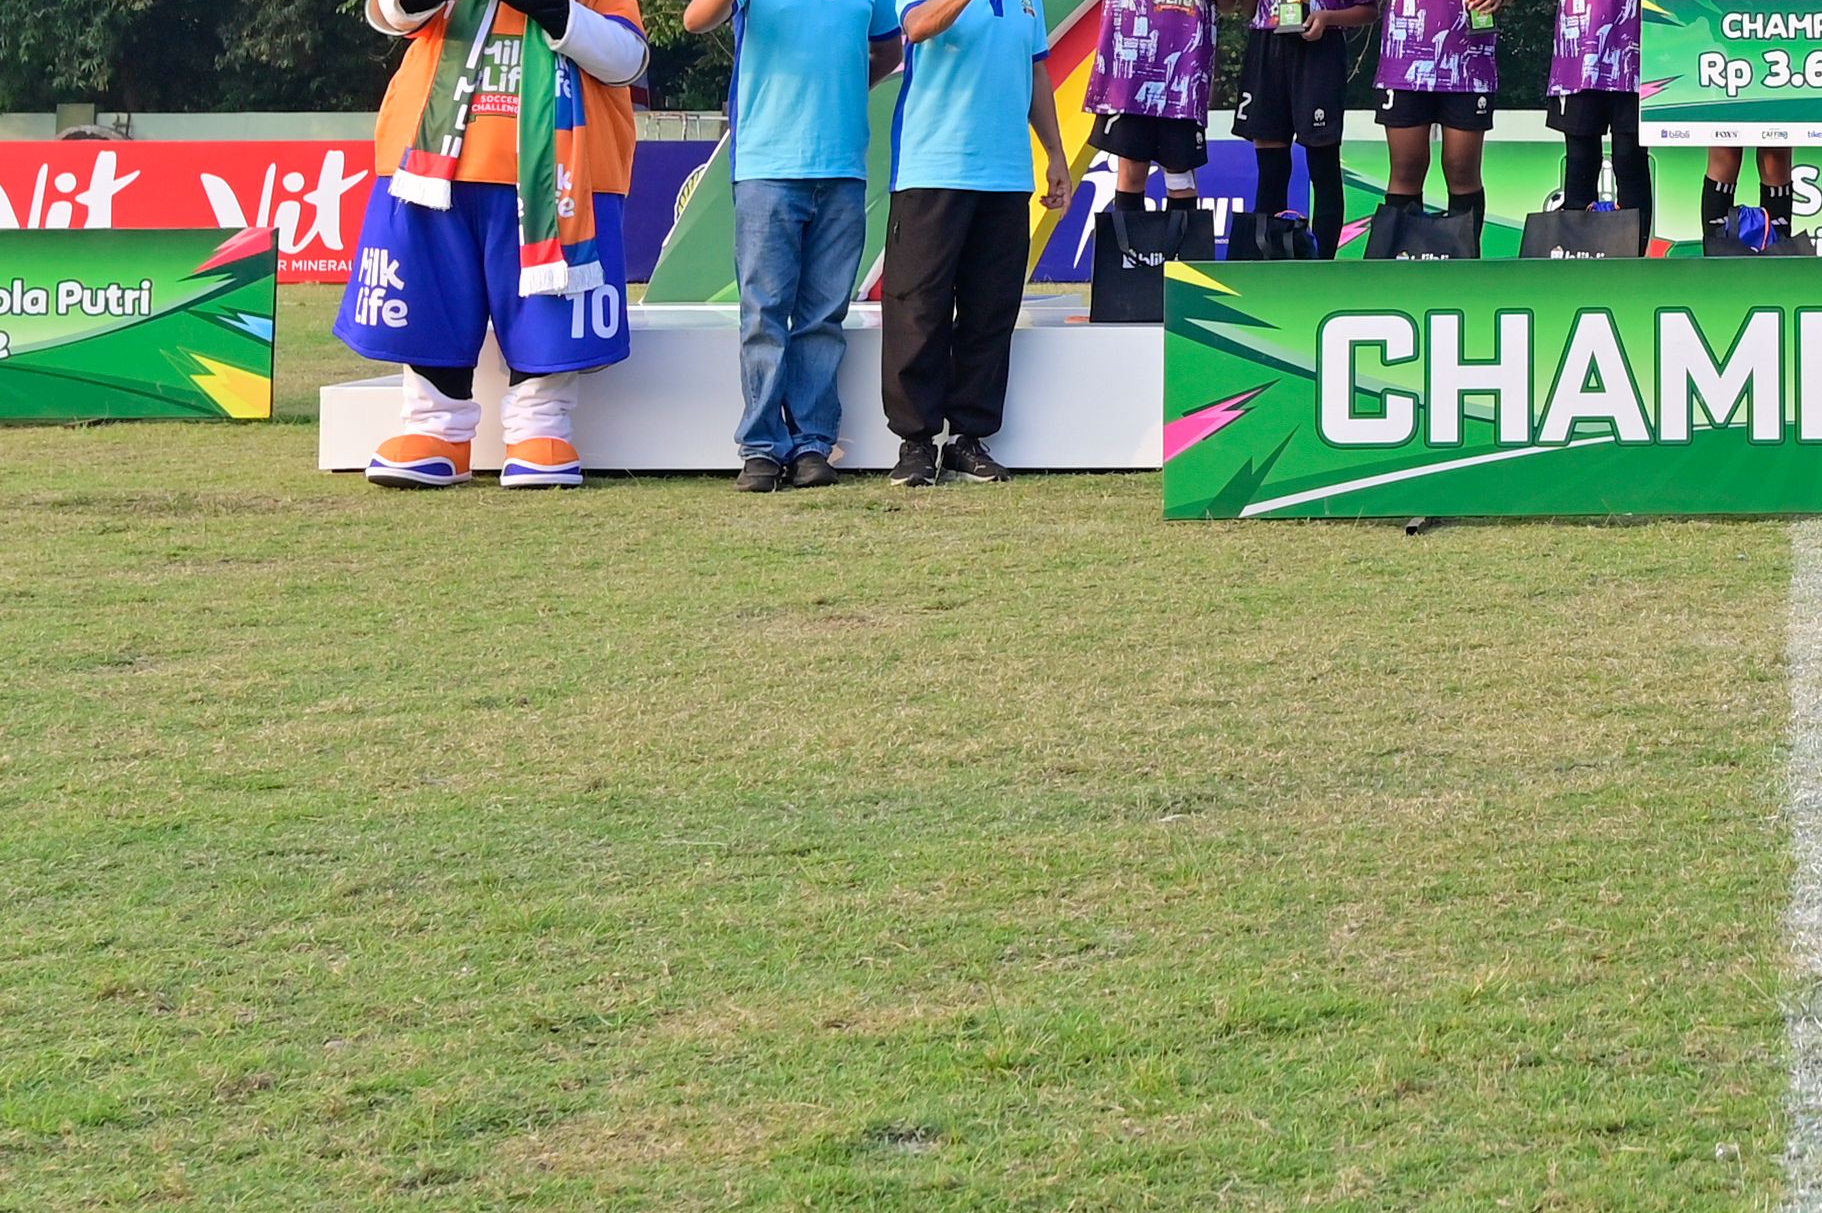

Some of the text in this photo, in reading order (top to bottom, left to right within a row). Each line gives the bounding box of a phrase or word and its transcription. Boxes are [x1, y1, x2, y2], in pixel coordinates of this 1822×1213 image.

[482, 65, 521, 92] Lif
[1699, 51, 1752, 97] Rp
[471, 104, 520, 113] CHALLENG
[1236, 91, 1253, 121] 2
[200, 149, 369, 255] Vit
[291, 259, 354, 272] MINERAL
[358, 247, 405, 290] Milk
[57, 279, 153, 316] Putri
[355, 286, 409, 328] Life
[565, 283, 620, 339] 10
